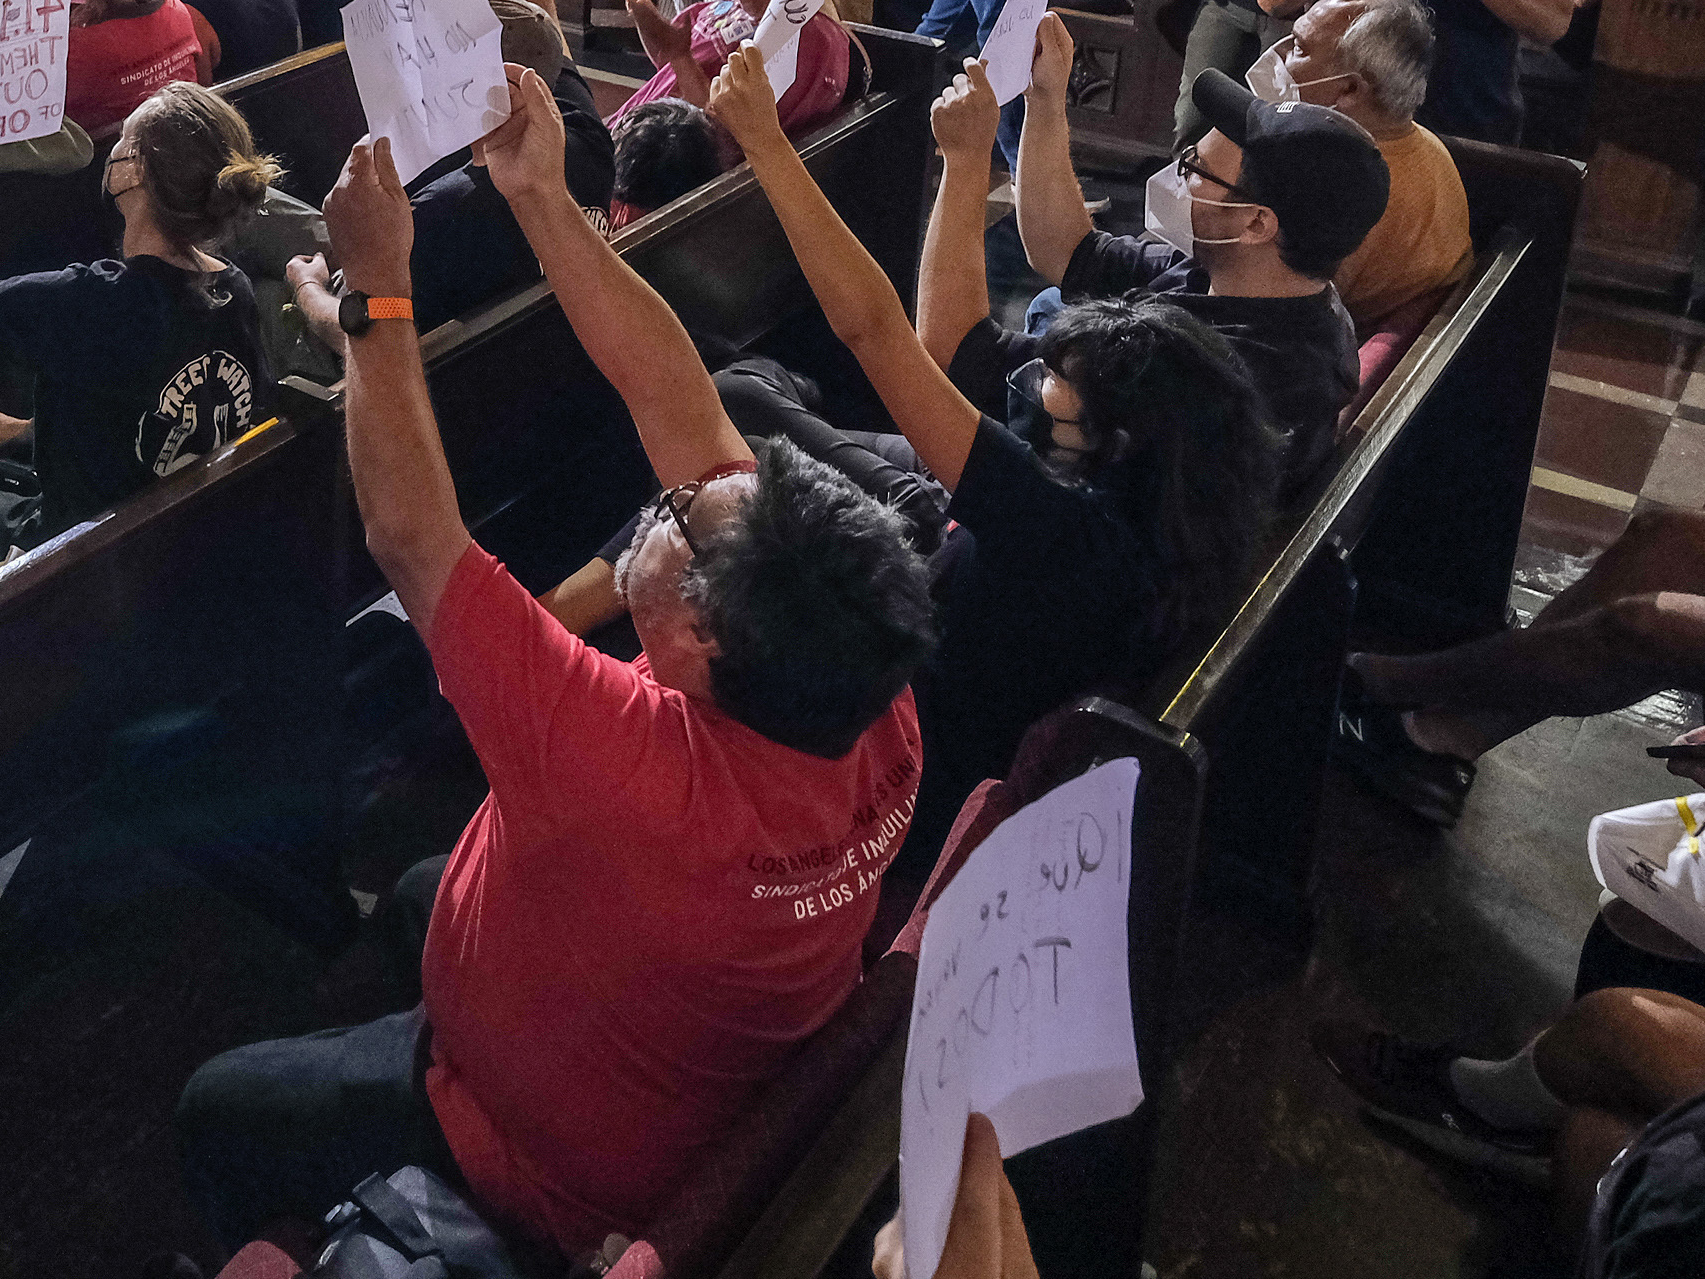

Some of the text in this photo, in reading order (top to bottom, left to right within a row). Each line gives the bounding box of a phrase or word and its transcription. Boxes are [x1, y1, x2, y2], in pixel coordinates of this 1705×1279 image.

[216, 358, 252, 428] WATCH
[794, 896, 818, 920] DE
[818, 883, 854, 913] LOS
